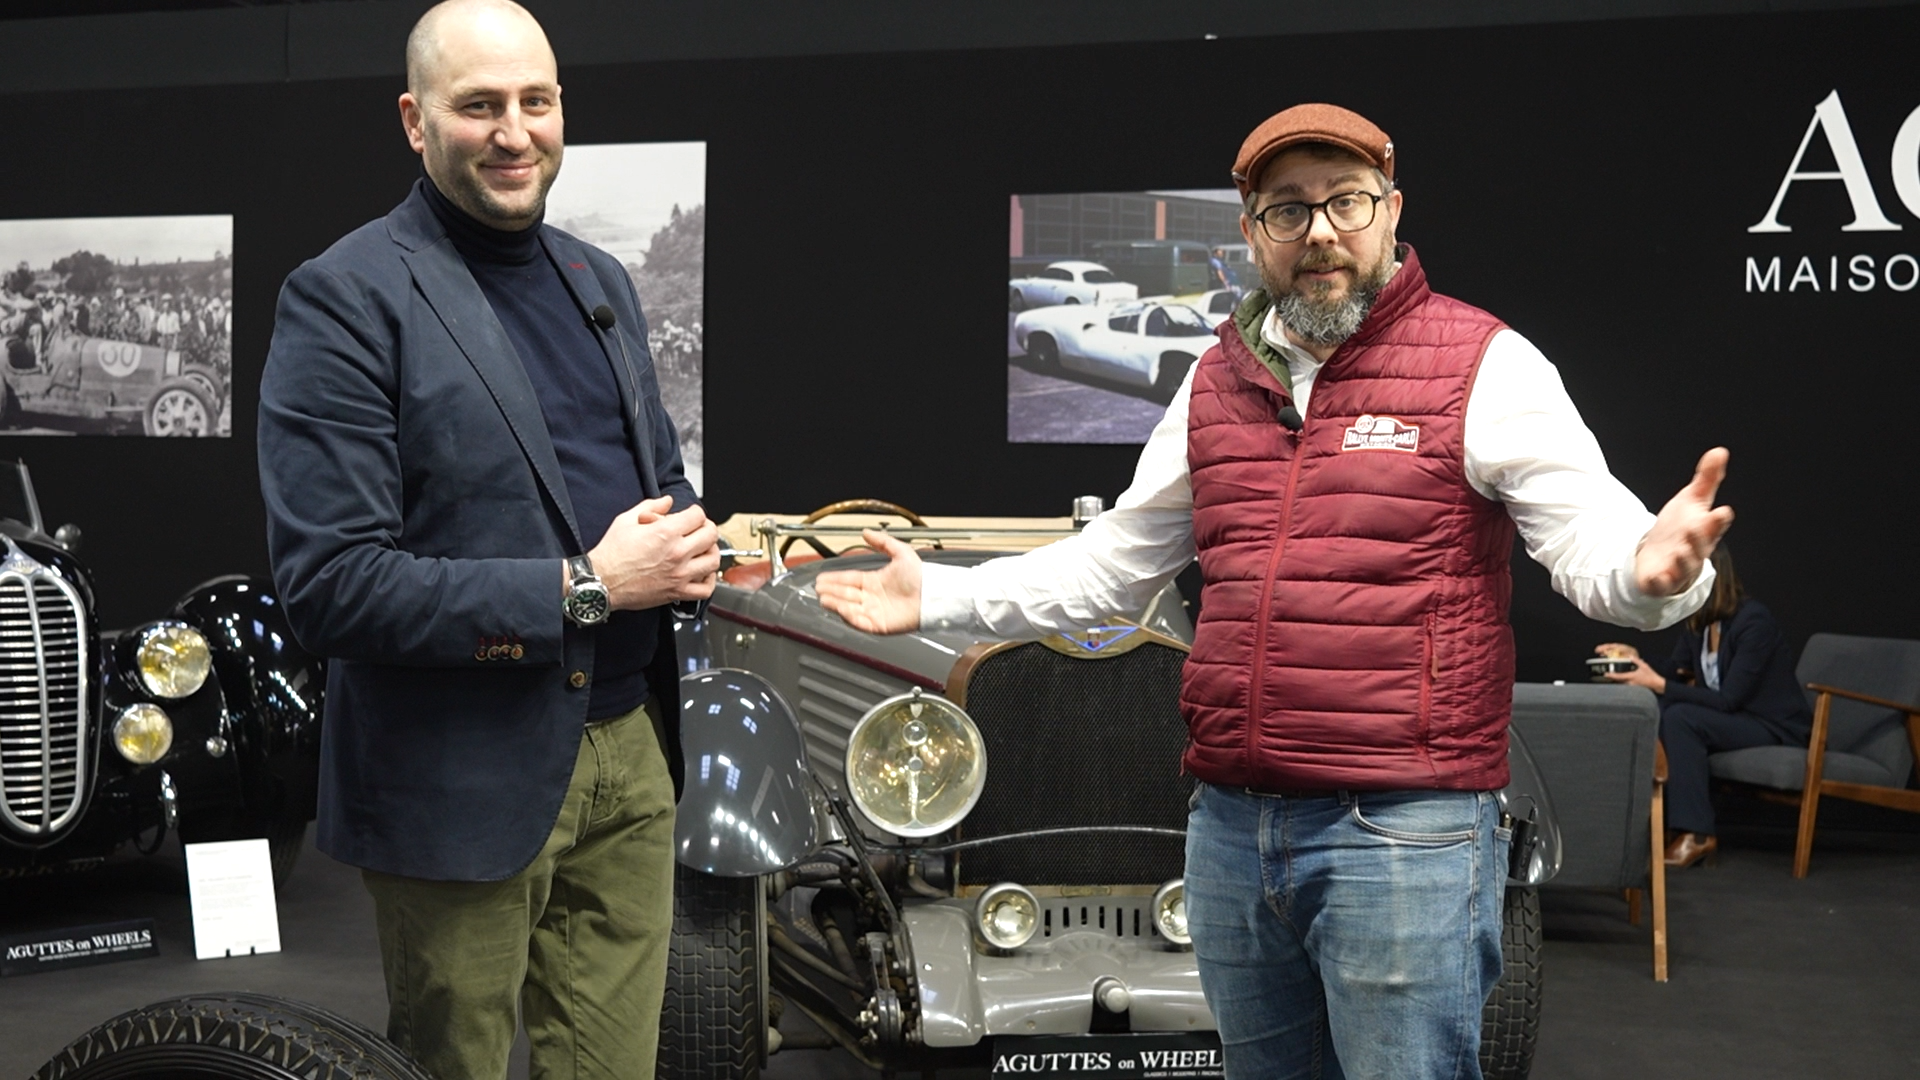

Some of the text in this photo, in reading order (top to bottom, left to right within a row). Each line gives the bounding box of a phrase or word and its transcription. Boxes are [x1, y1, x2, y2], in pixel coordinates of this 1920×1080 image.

[1747, 88, 1920, 233] A
[1745, 253, 1920, 293] MAISO
[6, 939, 75, 960] AGUTTES
[76, 940, 91, 951] on
[92, 929, 152, 949] WHEELS
[992, 1050, 1222, 1073] AGUTTES on WHEEL
